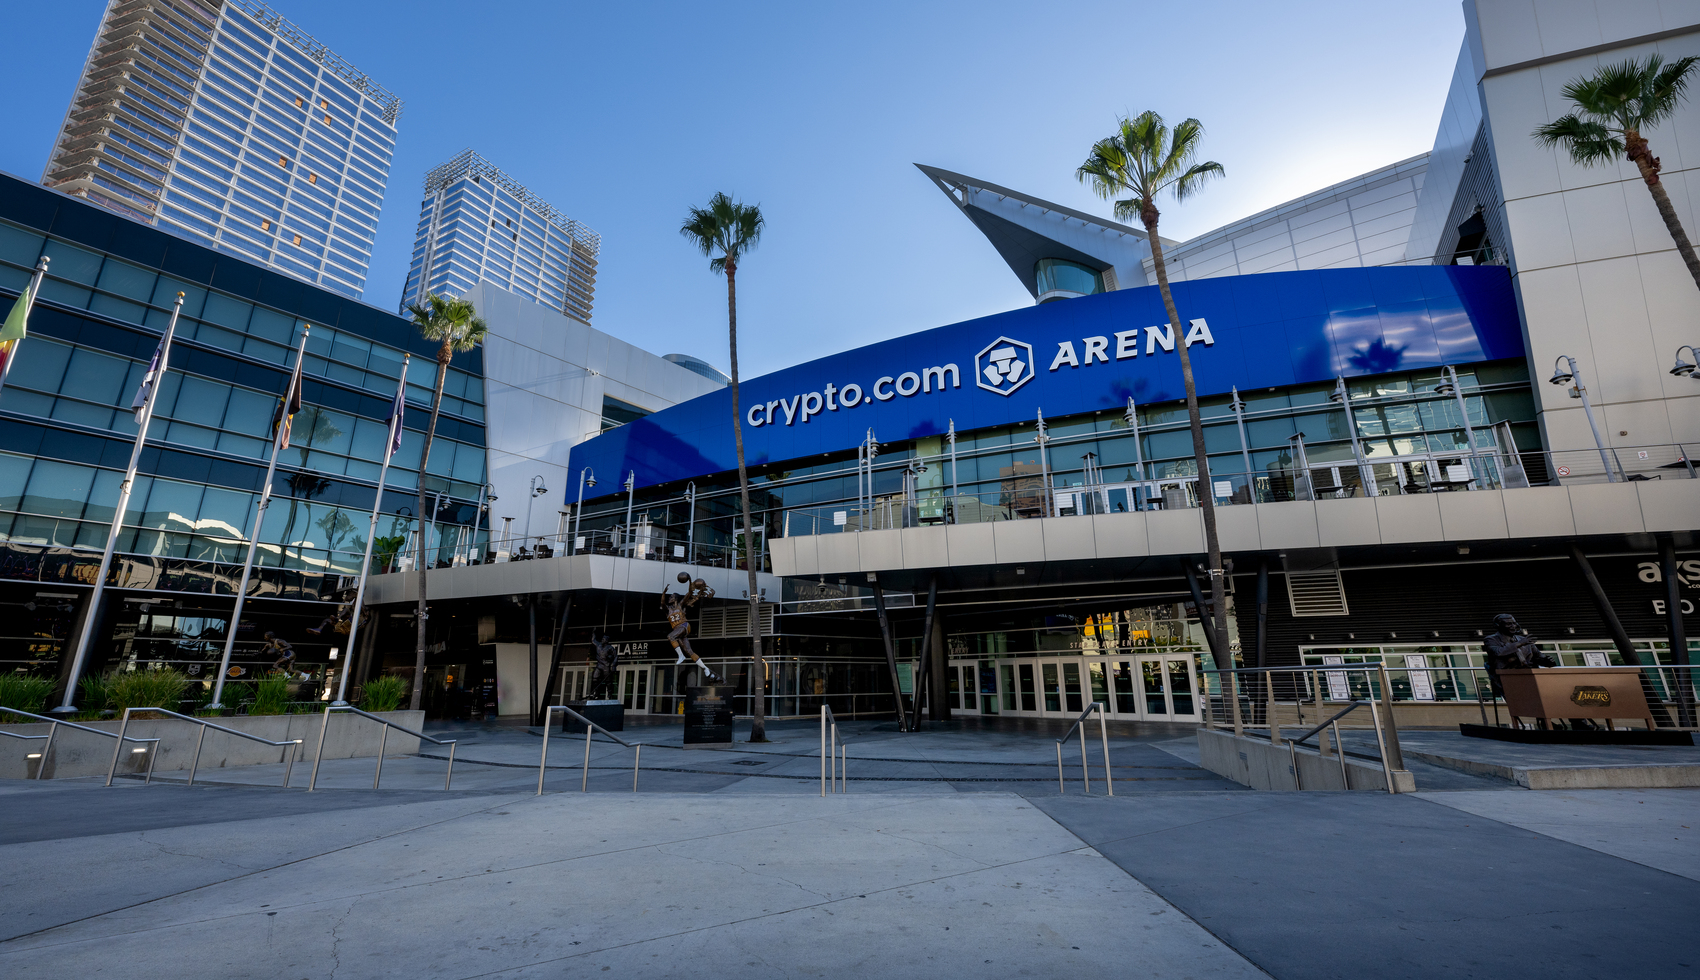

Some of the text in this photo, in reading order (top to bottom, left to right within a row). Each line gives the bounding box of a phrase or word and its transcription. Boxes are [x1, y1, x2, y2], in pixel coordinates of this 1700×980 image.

[747, 318, 1215, 427] crypto.com ARENA
[670, 614, 680, 622] 22
[1121, 638, 1148, 647] ENTRY
[1578, 691, 1610, 702] LAKERS
